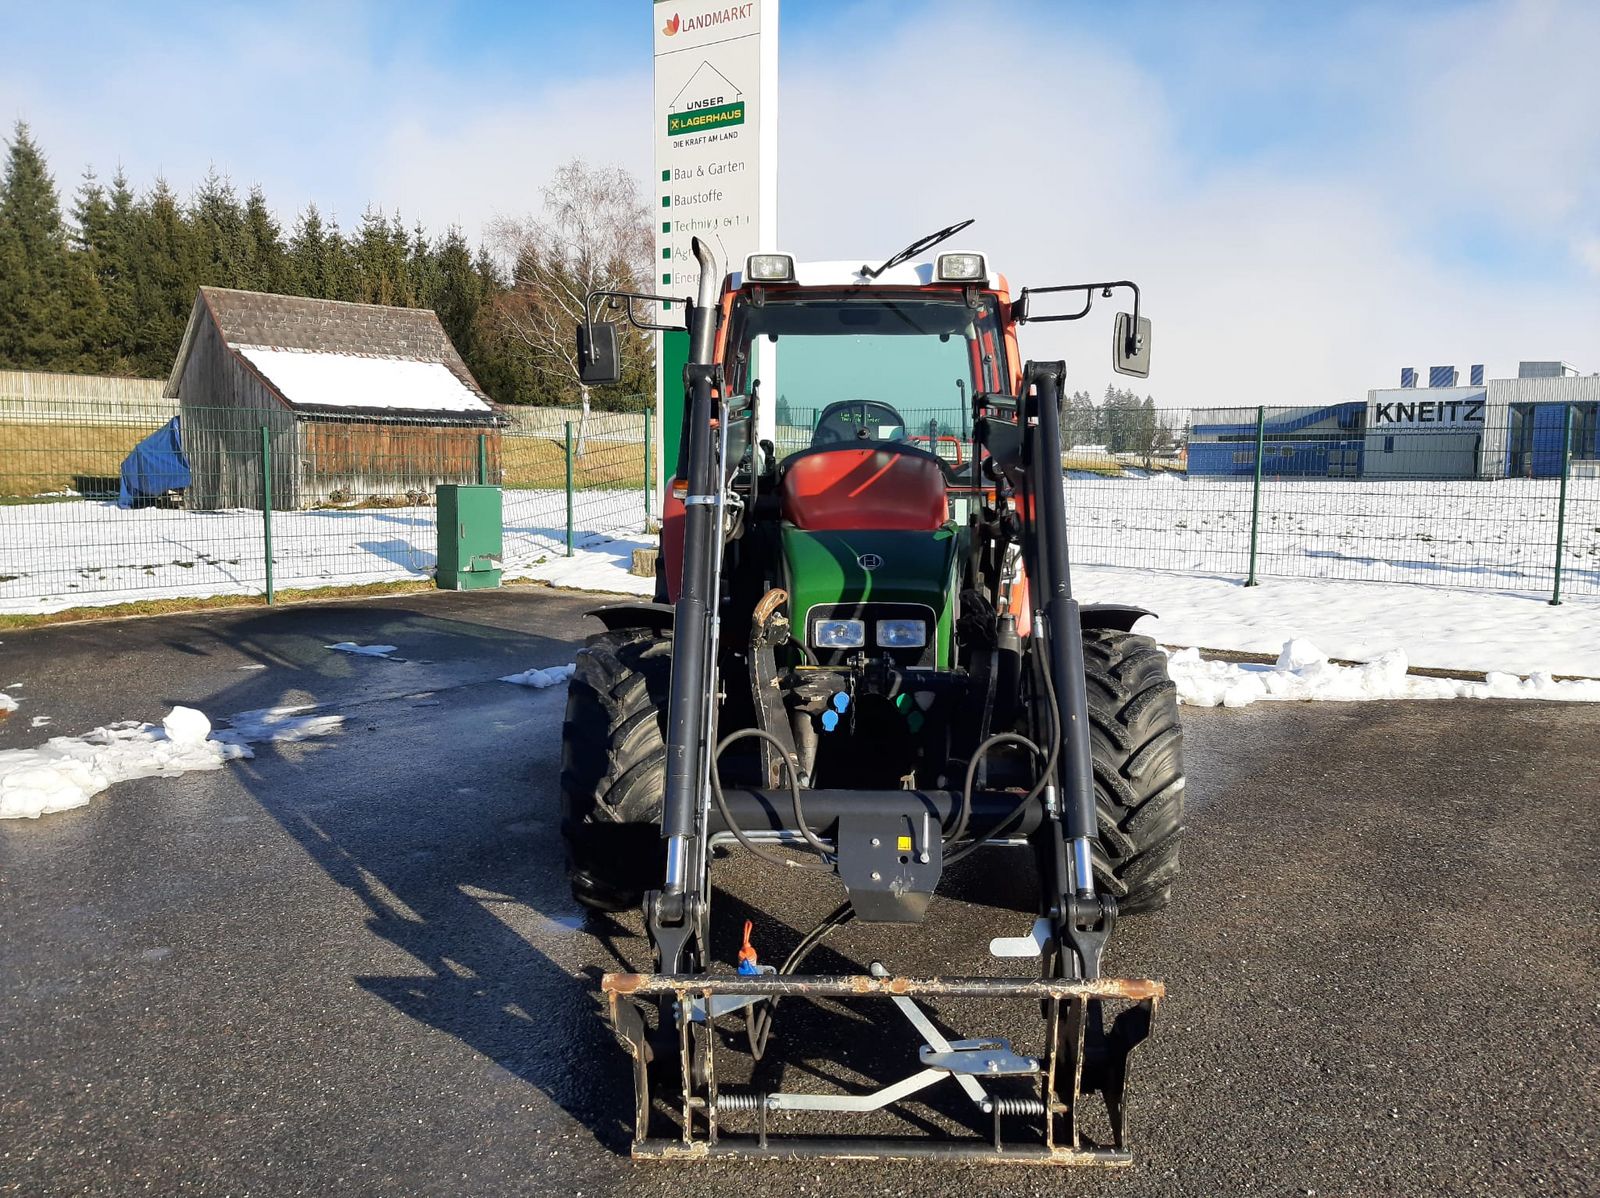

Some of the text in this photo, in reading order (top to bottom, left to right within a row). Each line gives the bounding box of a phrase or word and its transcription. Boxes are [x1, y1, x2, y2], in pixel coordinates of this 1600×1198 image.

[682, 3, 753, 32] LANDMARKT
[686, 96, 724, 110] UNSER
[680, 109, 741, 128] LAGERHAUS
[673, 131, 738, 149] DIE KRAFT AM LAND
[674, 161, 745, 181] Bau & Garten
[674, 189, 723, 206] Baustoffe
[1376, 400, 1485, 423] KNEITZ
